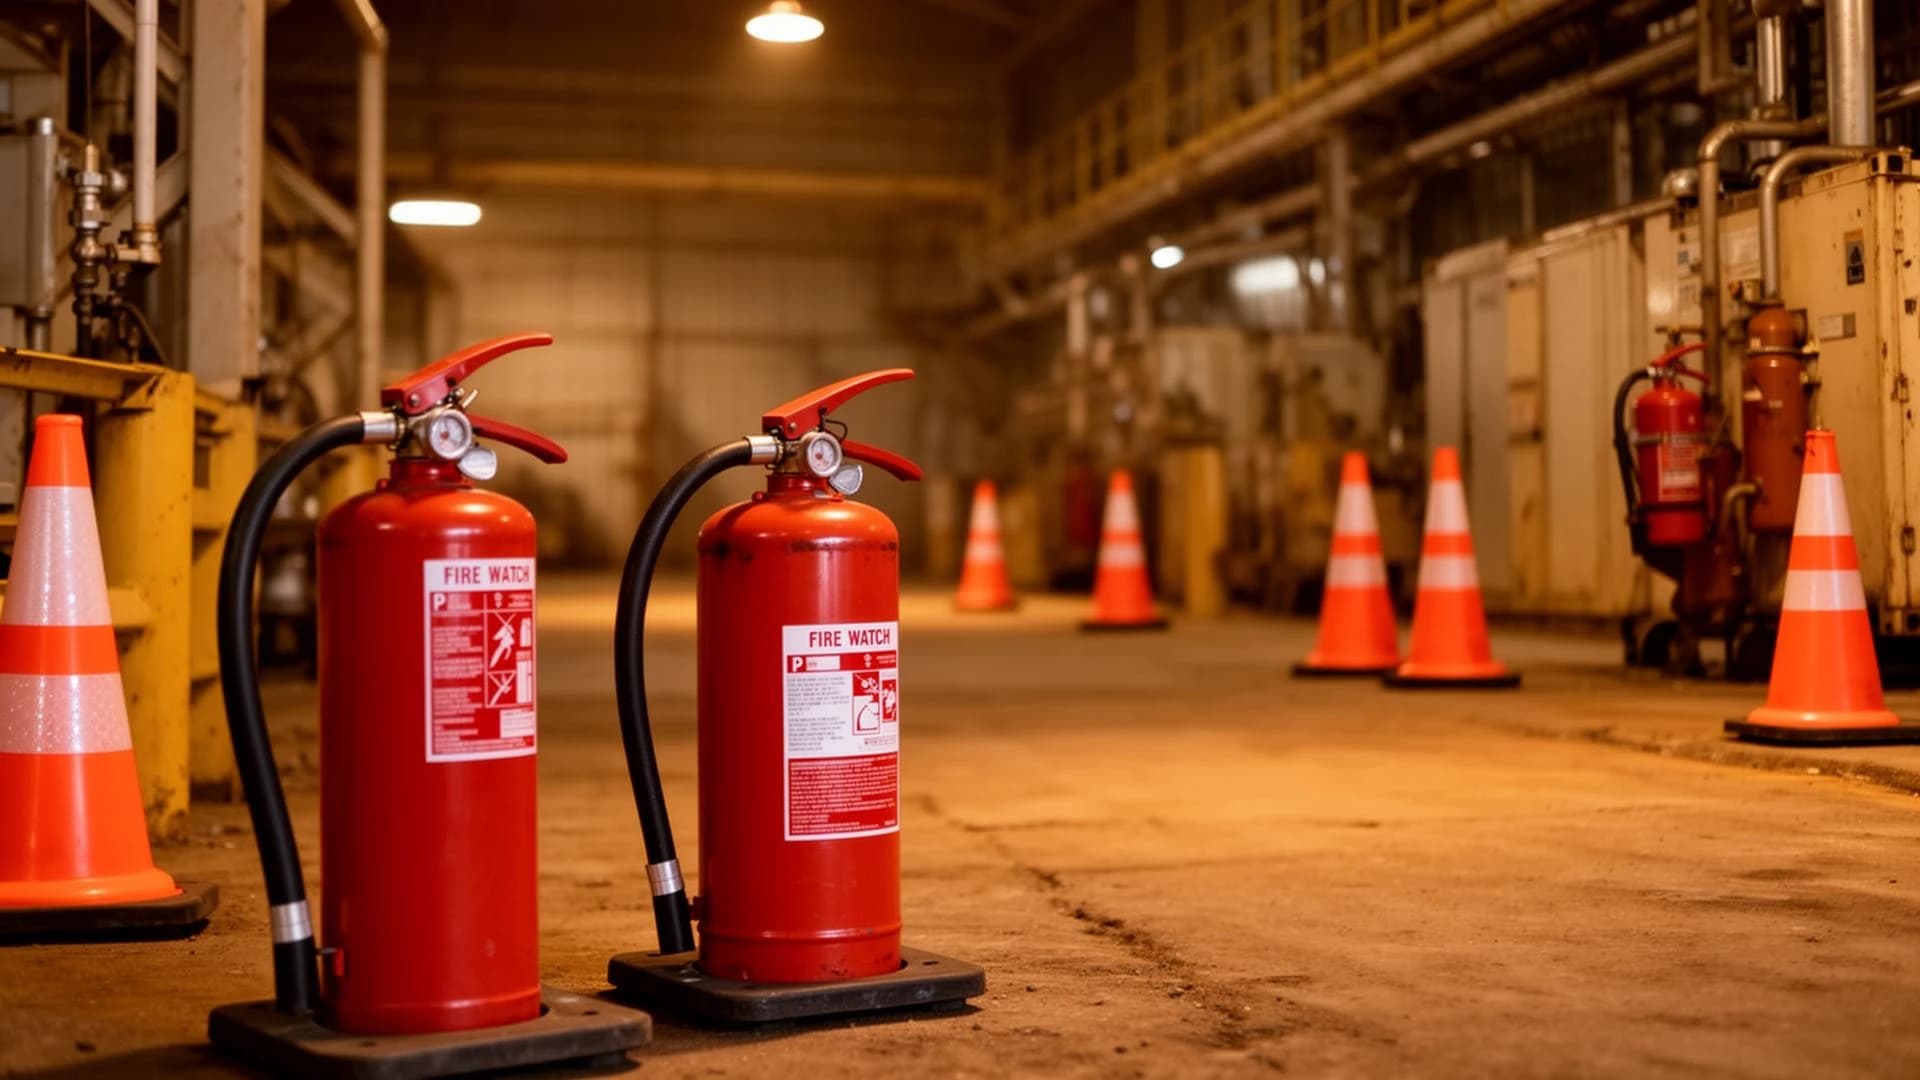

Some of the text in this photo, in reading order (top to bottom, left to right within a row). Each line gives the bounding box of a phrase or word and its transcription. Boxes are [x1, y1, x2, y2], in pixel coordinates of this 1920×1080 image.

[444, 565, 530, 585] FIRE WATCH
[809, 628, 891, 648] FIRE WATCH
